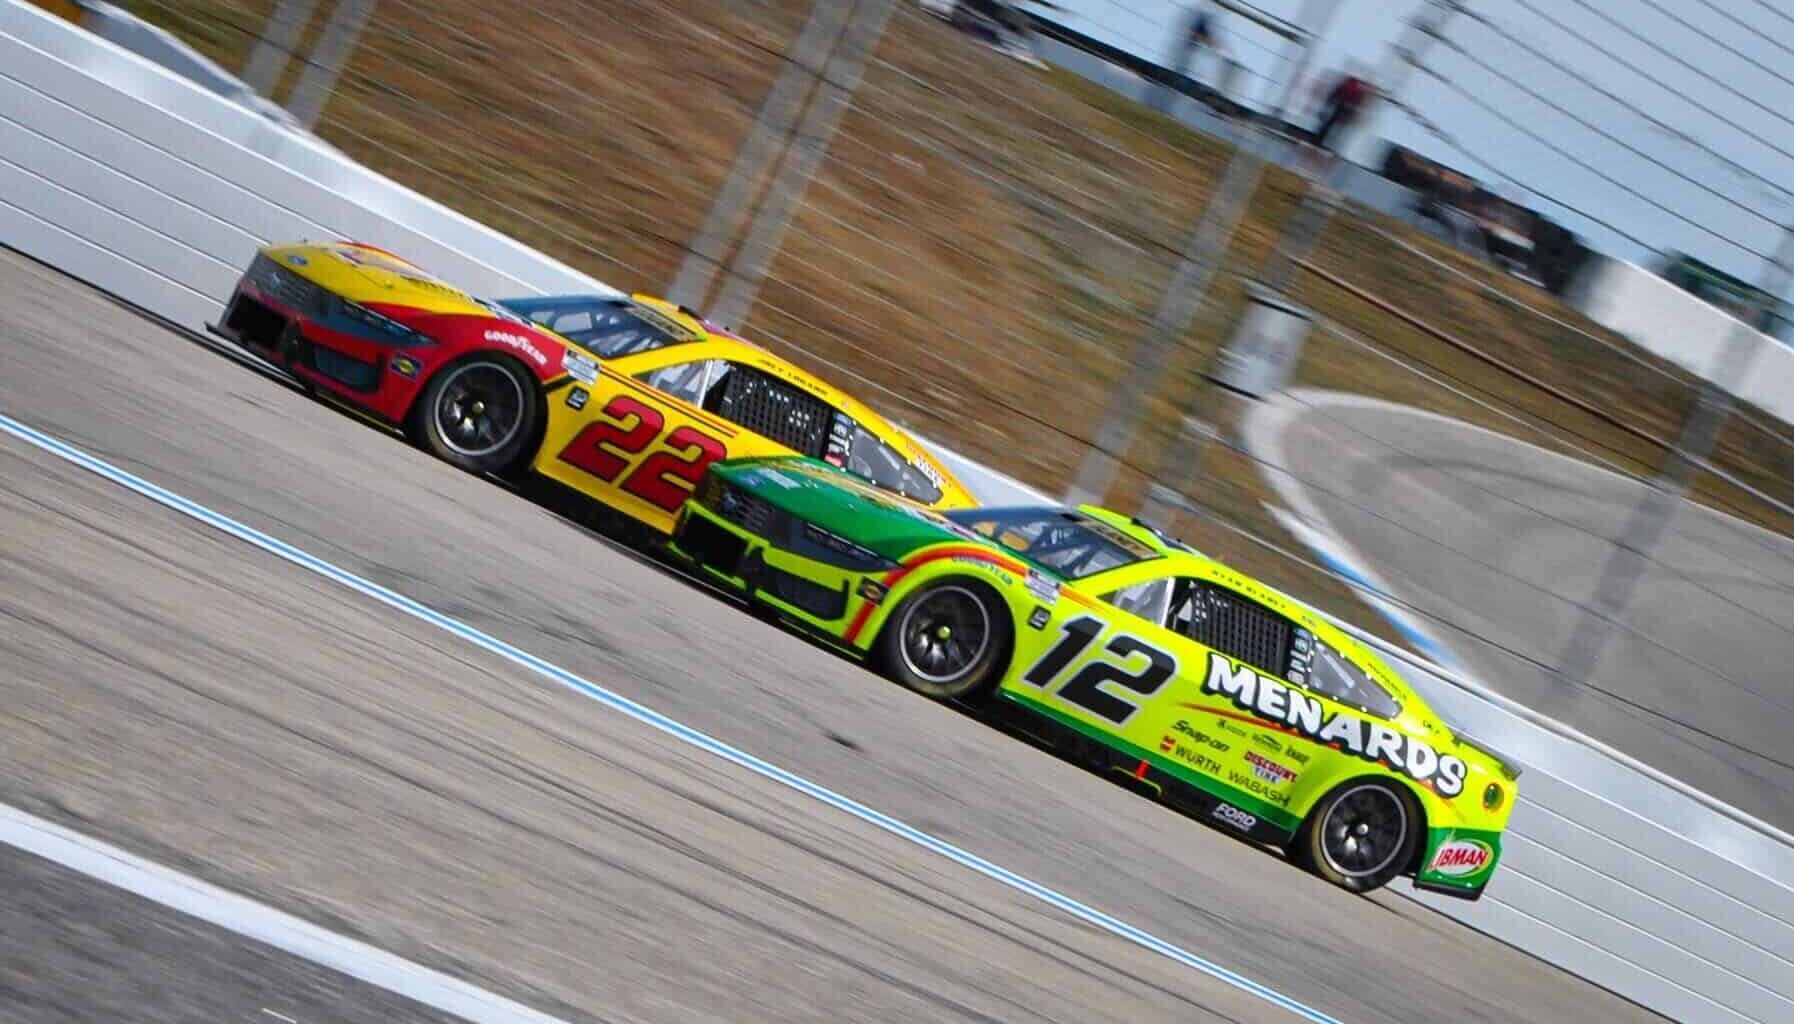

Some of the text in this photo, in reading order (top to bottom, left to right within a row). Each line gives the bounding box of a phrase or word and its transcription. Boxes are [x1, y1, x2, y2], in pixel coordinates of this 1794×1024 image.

[557, 395, 727, 514] 22
[1022, 615, 1176, 726] 12
[1206, 652, 1468, 798] MENARDS
[1243, 750, 1298, 784] DISCOUNT
[1253, 766, 1281, 784] TIRE
[1229, 770, 1291, 808] WABASH
[1214, 802, 1257, 827] FORD
